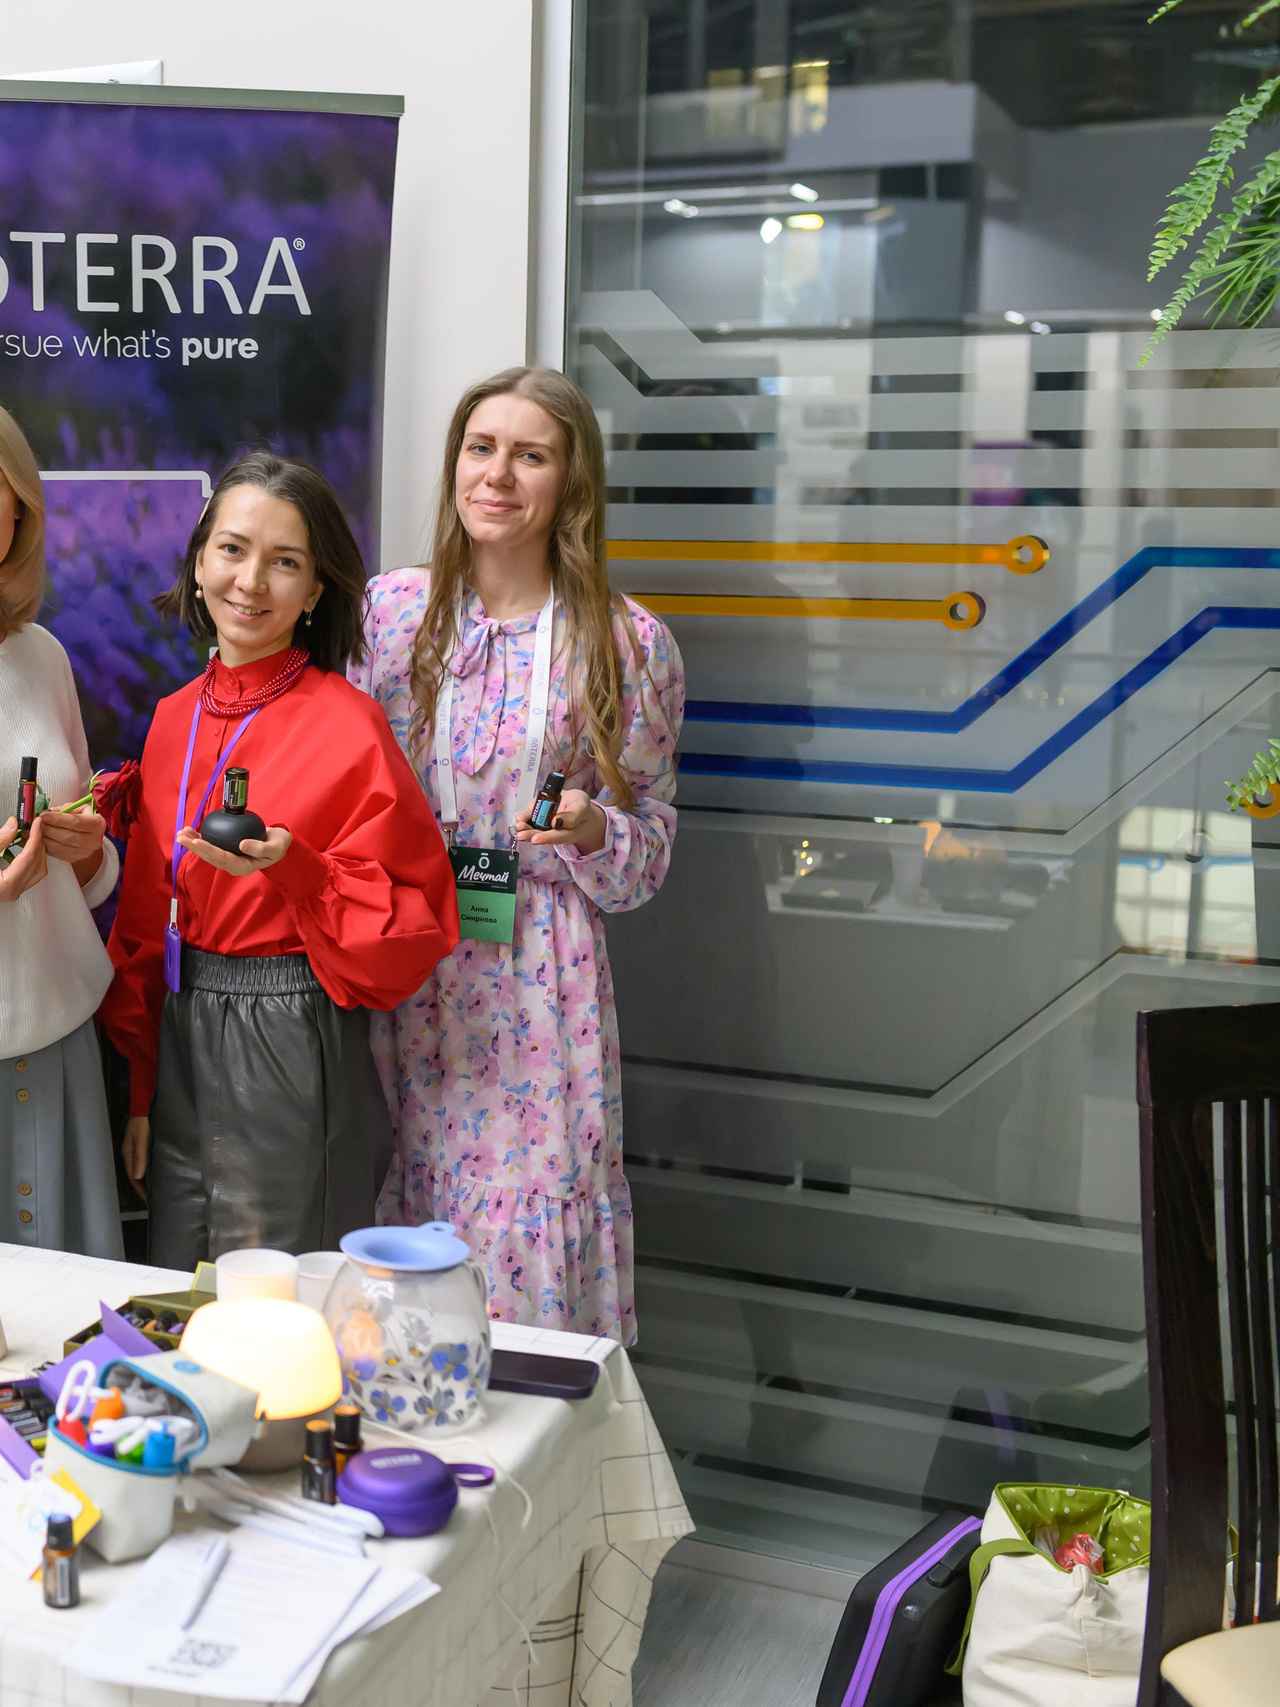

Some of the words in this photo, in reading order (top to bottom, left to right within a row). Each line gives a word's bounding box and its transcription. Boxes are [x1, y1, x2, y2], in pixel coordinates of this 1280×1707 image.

[72, 328, 171, 359] what's
[181, 336, 259, 366] pure
[457, 864, 510, 884] Мечтай
[470, 905, 489, 913] Анна
[460, 914, 498, 924] Смирнова
